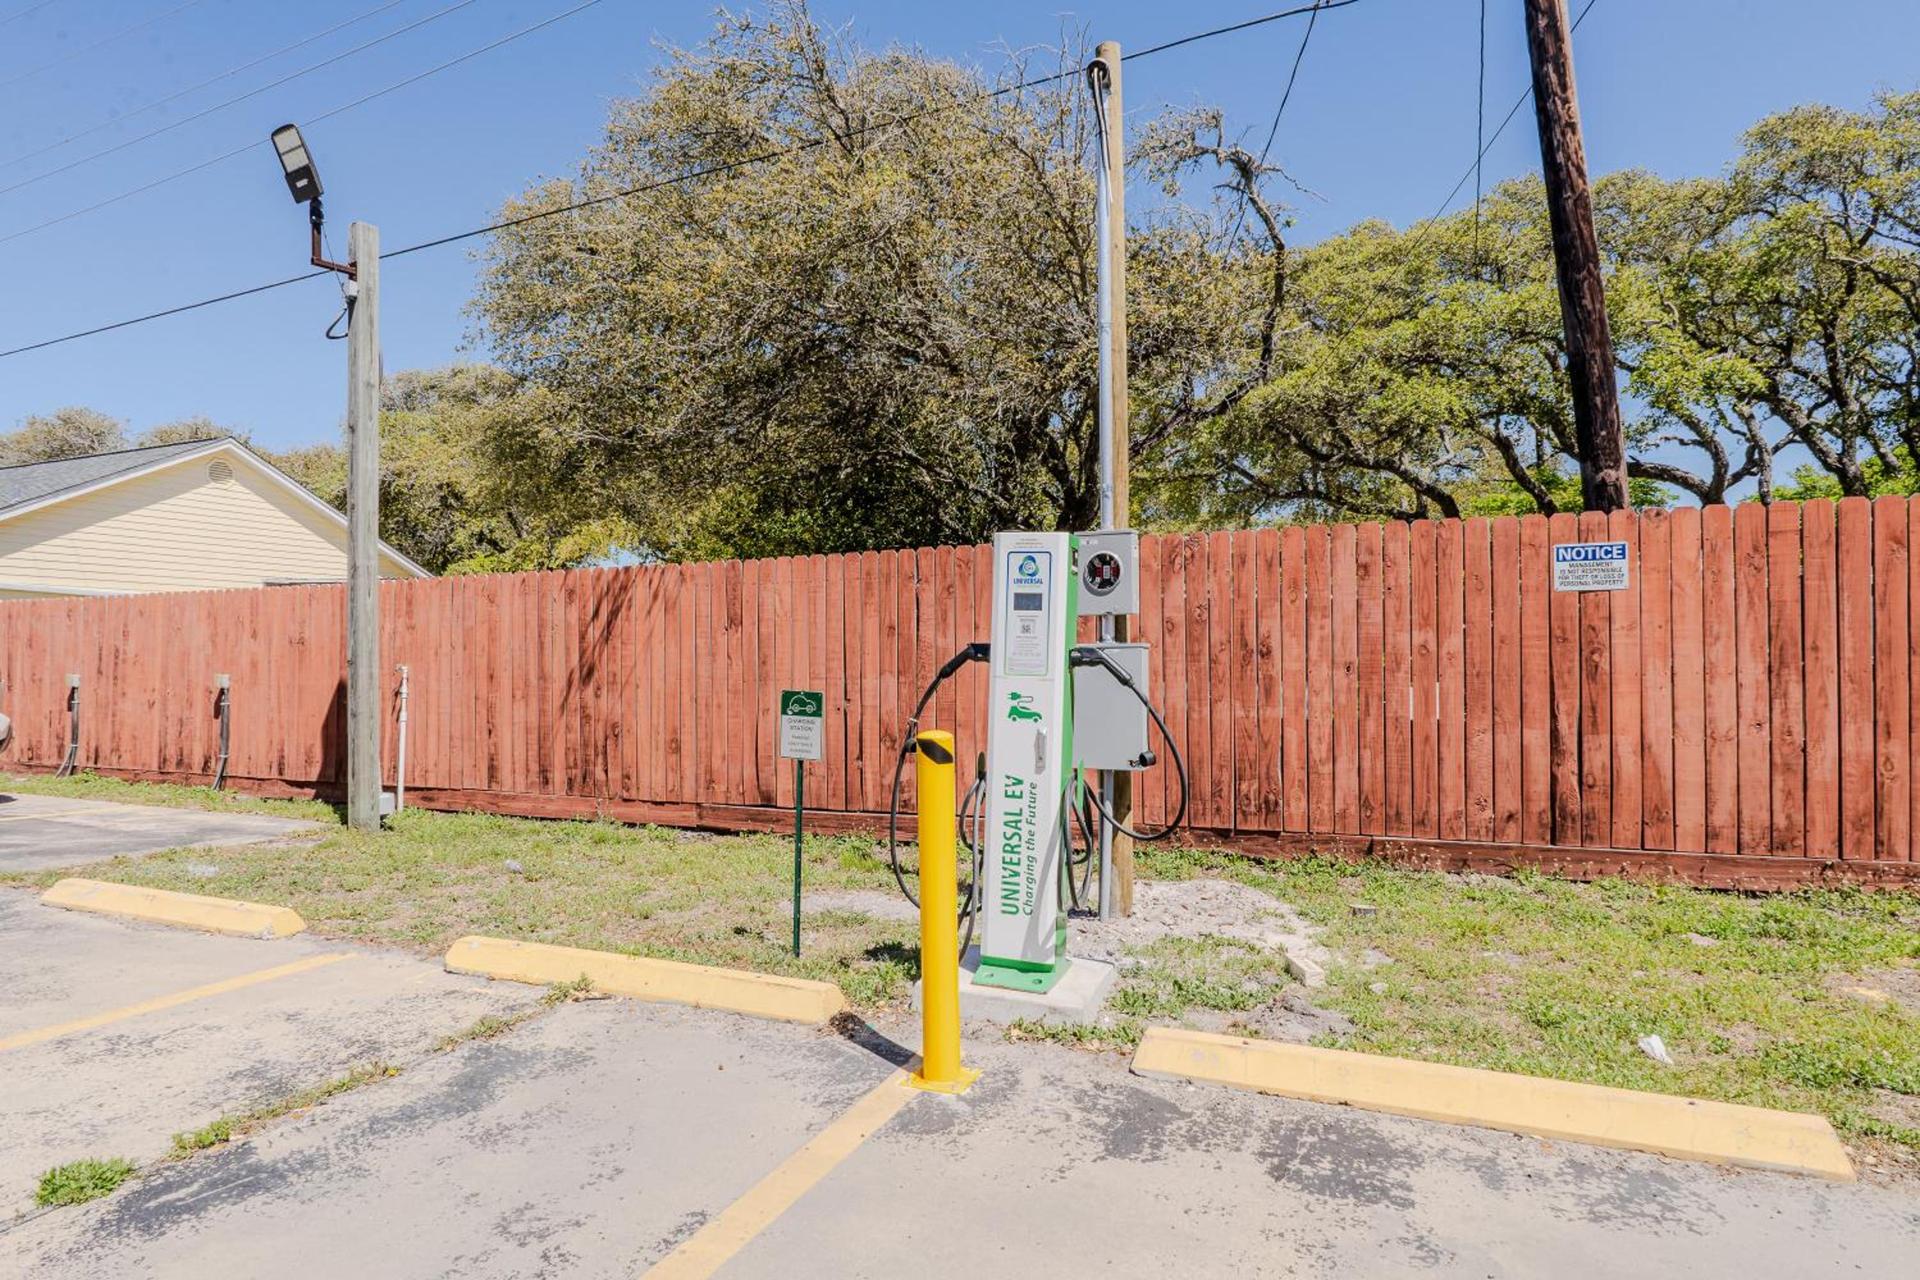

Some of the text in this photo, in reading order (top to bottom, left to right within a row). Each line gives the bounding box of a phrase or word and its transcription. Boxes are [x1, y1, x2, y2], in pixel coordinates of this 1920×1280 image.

[1013, 577, 1043, 585] UNIVERSAL
[1558, 546, 1623, 561] NOTICE
[1000, 774, 1025, 916] UNIVERSAL EV
[1022, 781, 1039, 917] Charging the Future
